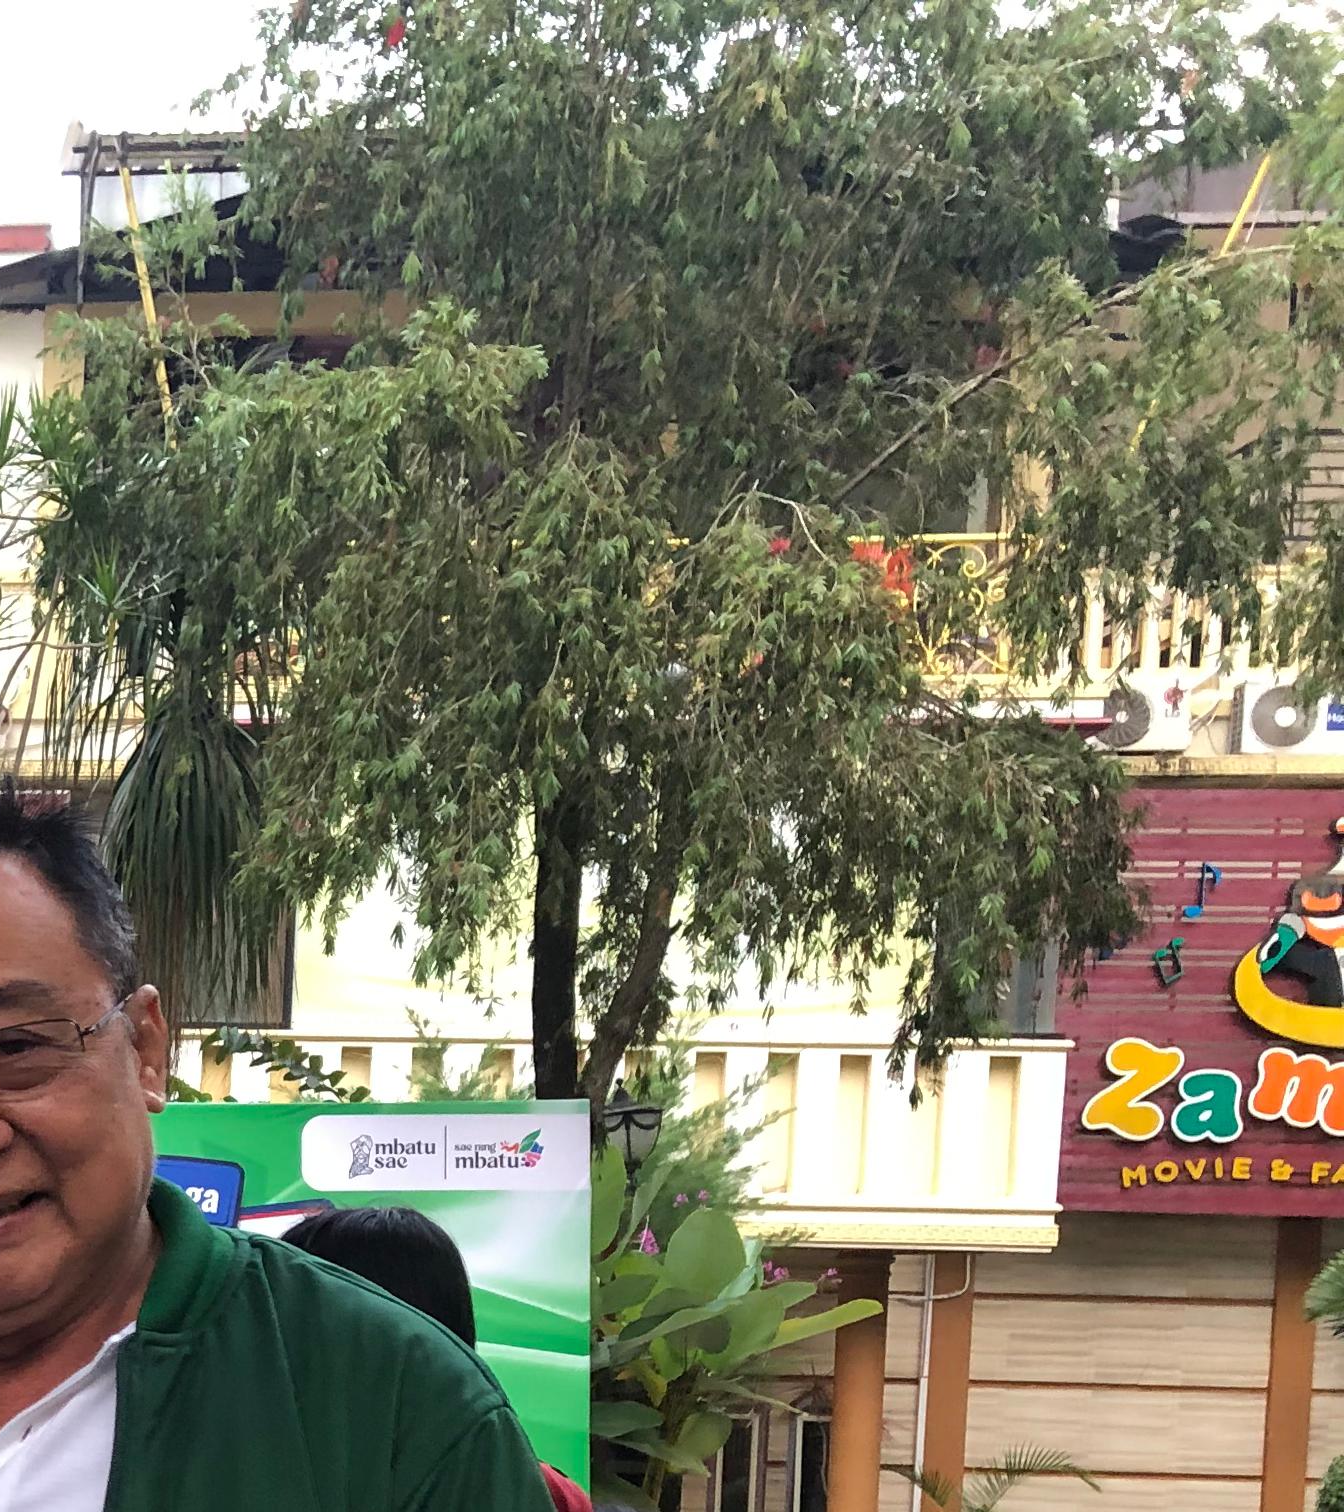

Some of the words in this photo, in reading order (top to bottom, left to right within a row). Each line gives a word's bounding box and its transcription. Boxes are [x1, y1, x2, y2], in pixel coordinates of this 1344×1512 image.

[375, 1138, 436, 1155] mbatu
[454, 1143, 472, 1152] sae
[474, 1142, 497, 1154] ning
[374, 1156, 408, 1169] sae
[454, 1152, 518, 1169] mbatu
[1121, 1157, 1253, 1188] MOVIE
[1270, 1159, 1295, 1181] &
